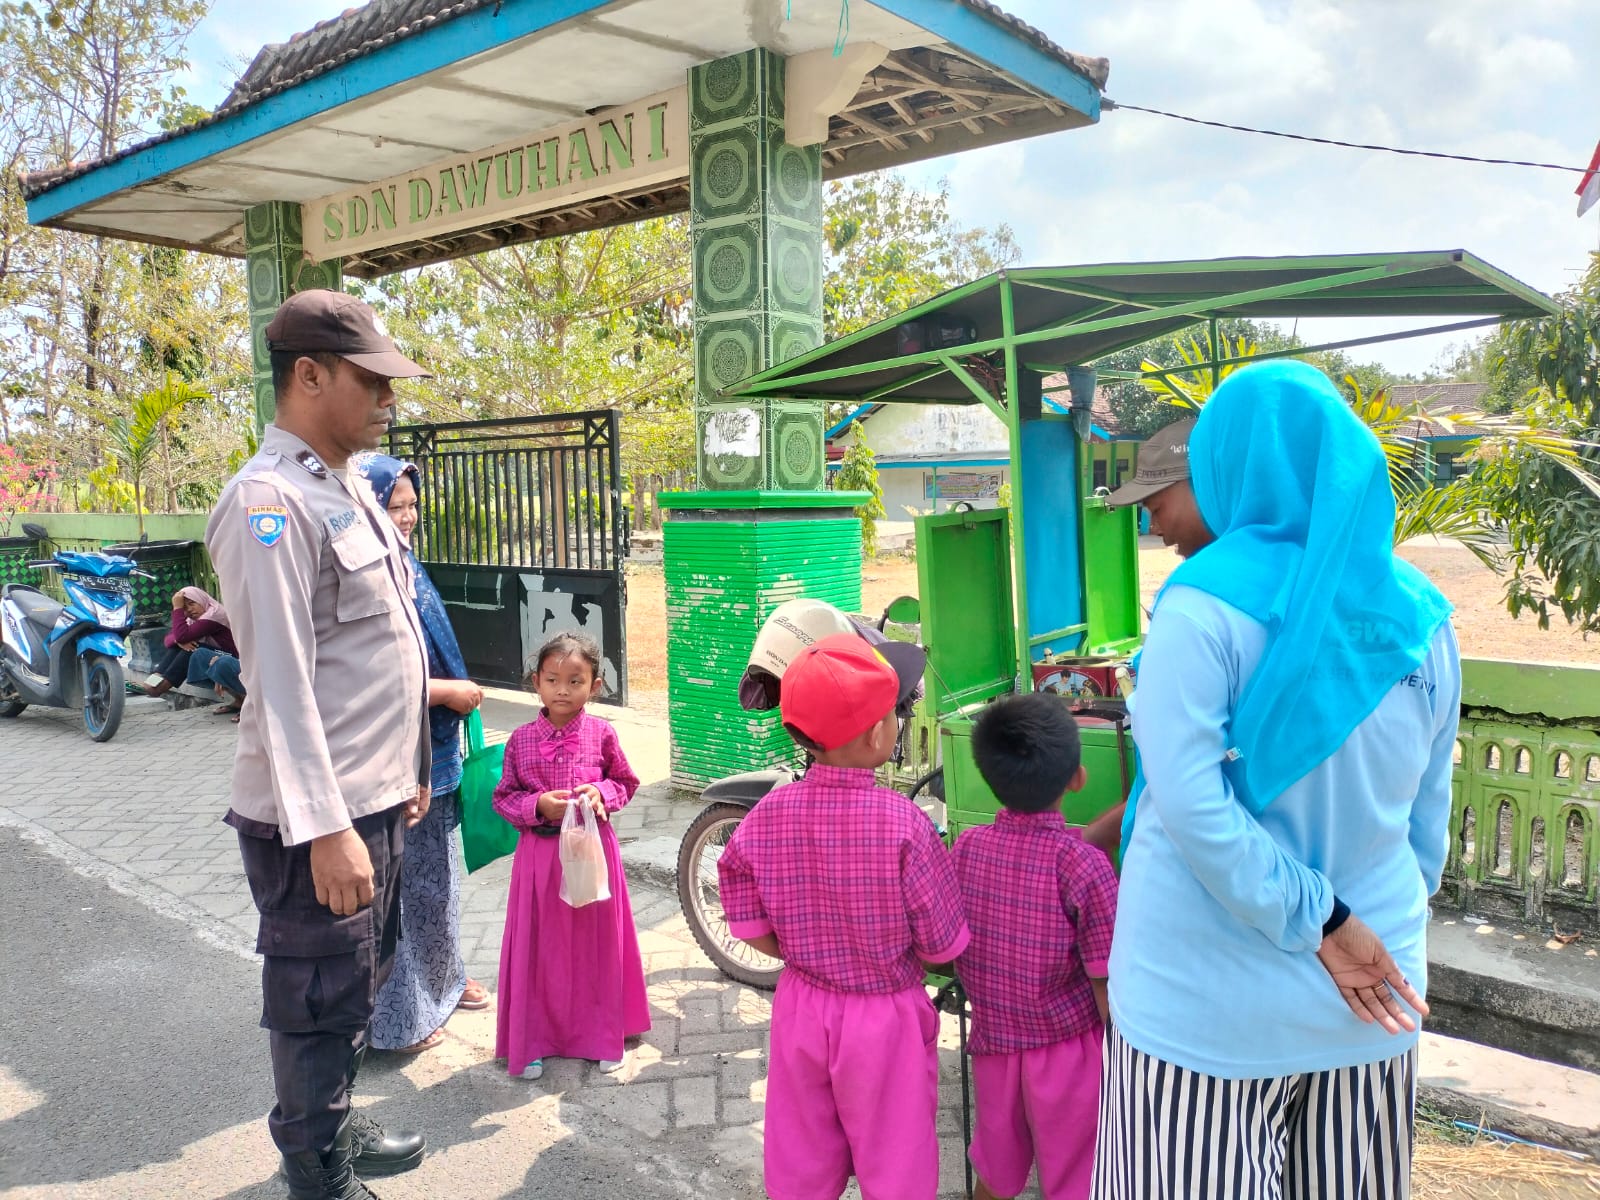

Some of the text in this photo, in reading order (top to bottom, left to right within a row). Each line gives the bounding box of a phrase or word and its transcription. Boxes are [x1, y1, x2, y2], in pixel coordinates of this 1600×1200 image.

[323, 101, 669, 243] SDN DAWUHAN I
[766, 650, 788, 668] HONDA
